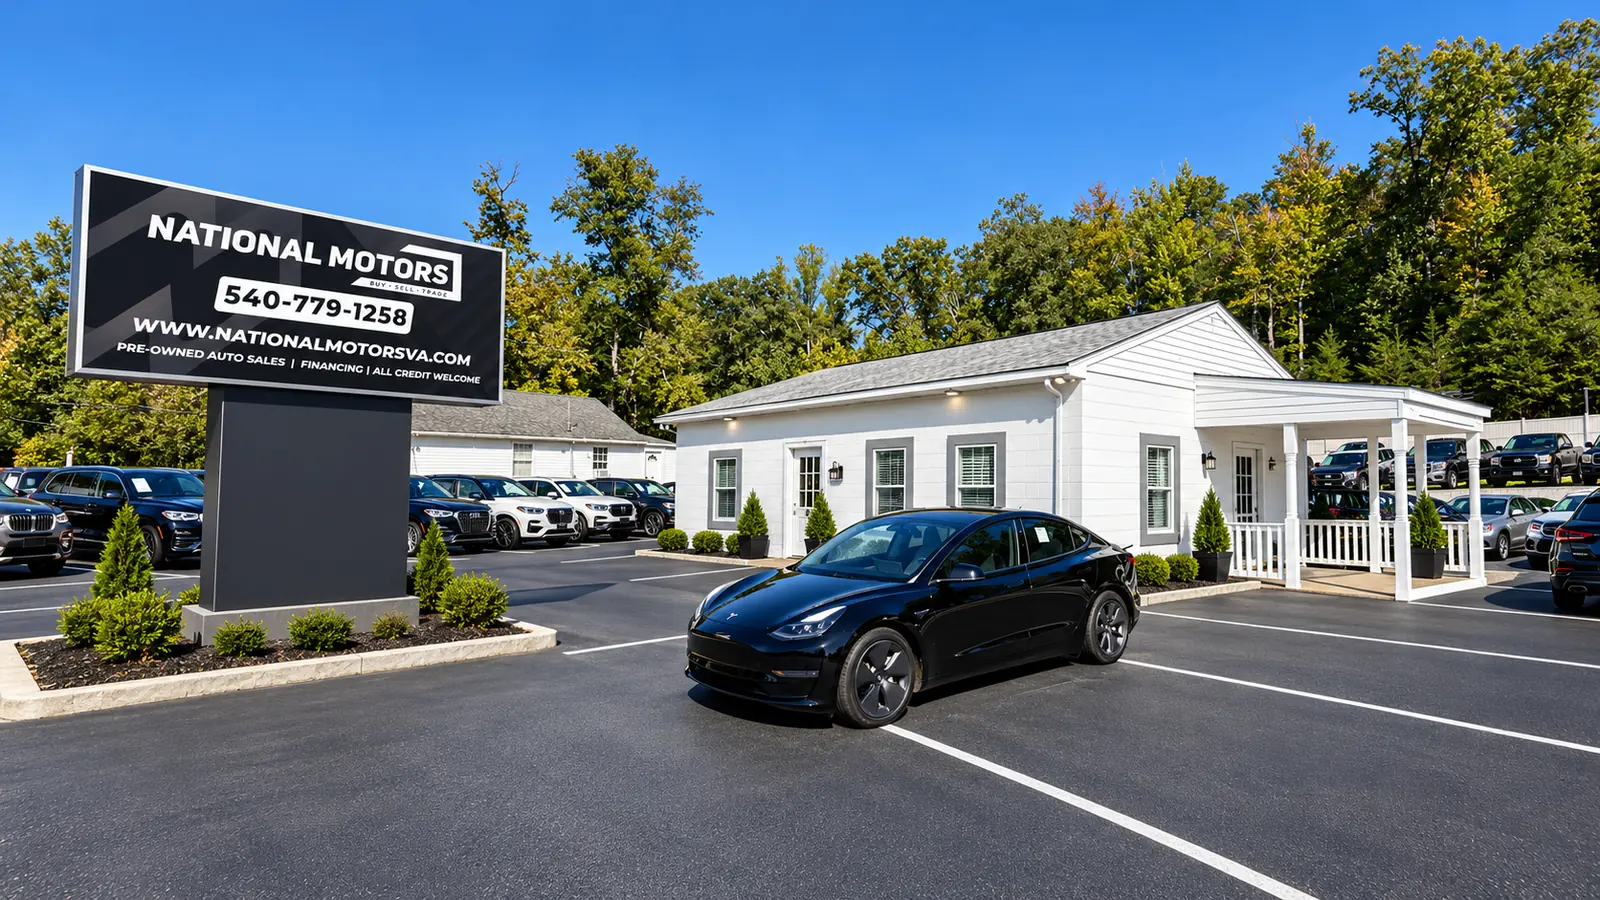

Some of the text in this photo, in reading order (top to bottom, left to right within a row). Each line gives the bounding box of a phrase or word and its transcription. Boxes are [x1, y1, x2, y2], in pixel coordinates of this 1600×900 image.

[147, 214, 449, 285] NATIONAL MOTORS
[223, 284, 408, 328] 540-779-1258
[369, 280, 387, 288] BUY
[394, 284, 415, 293] SELL
[116, 341, 481, 384] PRE-OWNED AUTO SALES FINANCING ALL CREDIT WELCOME
[133, 317, 471, 367] WWW.NATIONALMOTORSVA.COM
